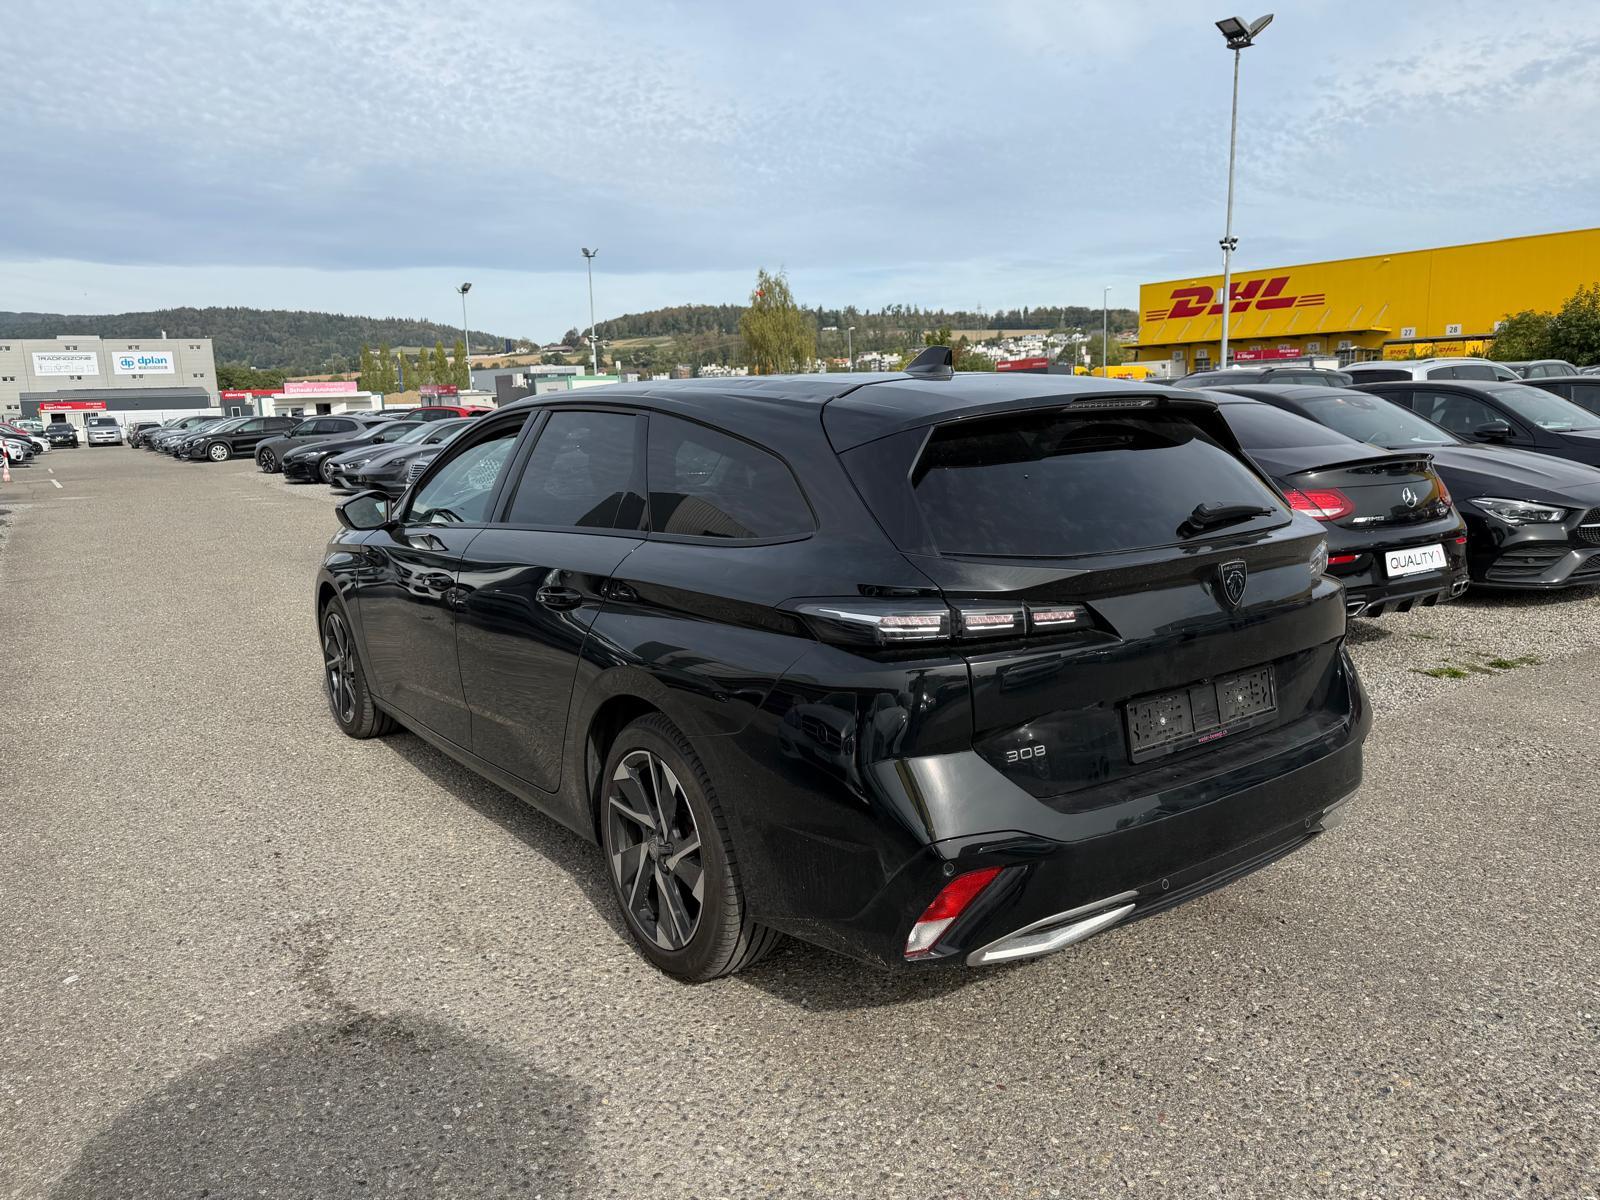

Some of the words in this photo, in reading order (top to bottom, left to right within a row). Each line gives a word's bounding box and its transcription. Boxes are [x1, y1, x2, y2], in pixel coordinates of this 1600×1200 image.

[1167, 276, 1298, 319] DHL
[137, 356, 168, 366] dplan
[1006, 744, 1047, 763] 308
